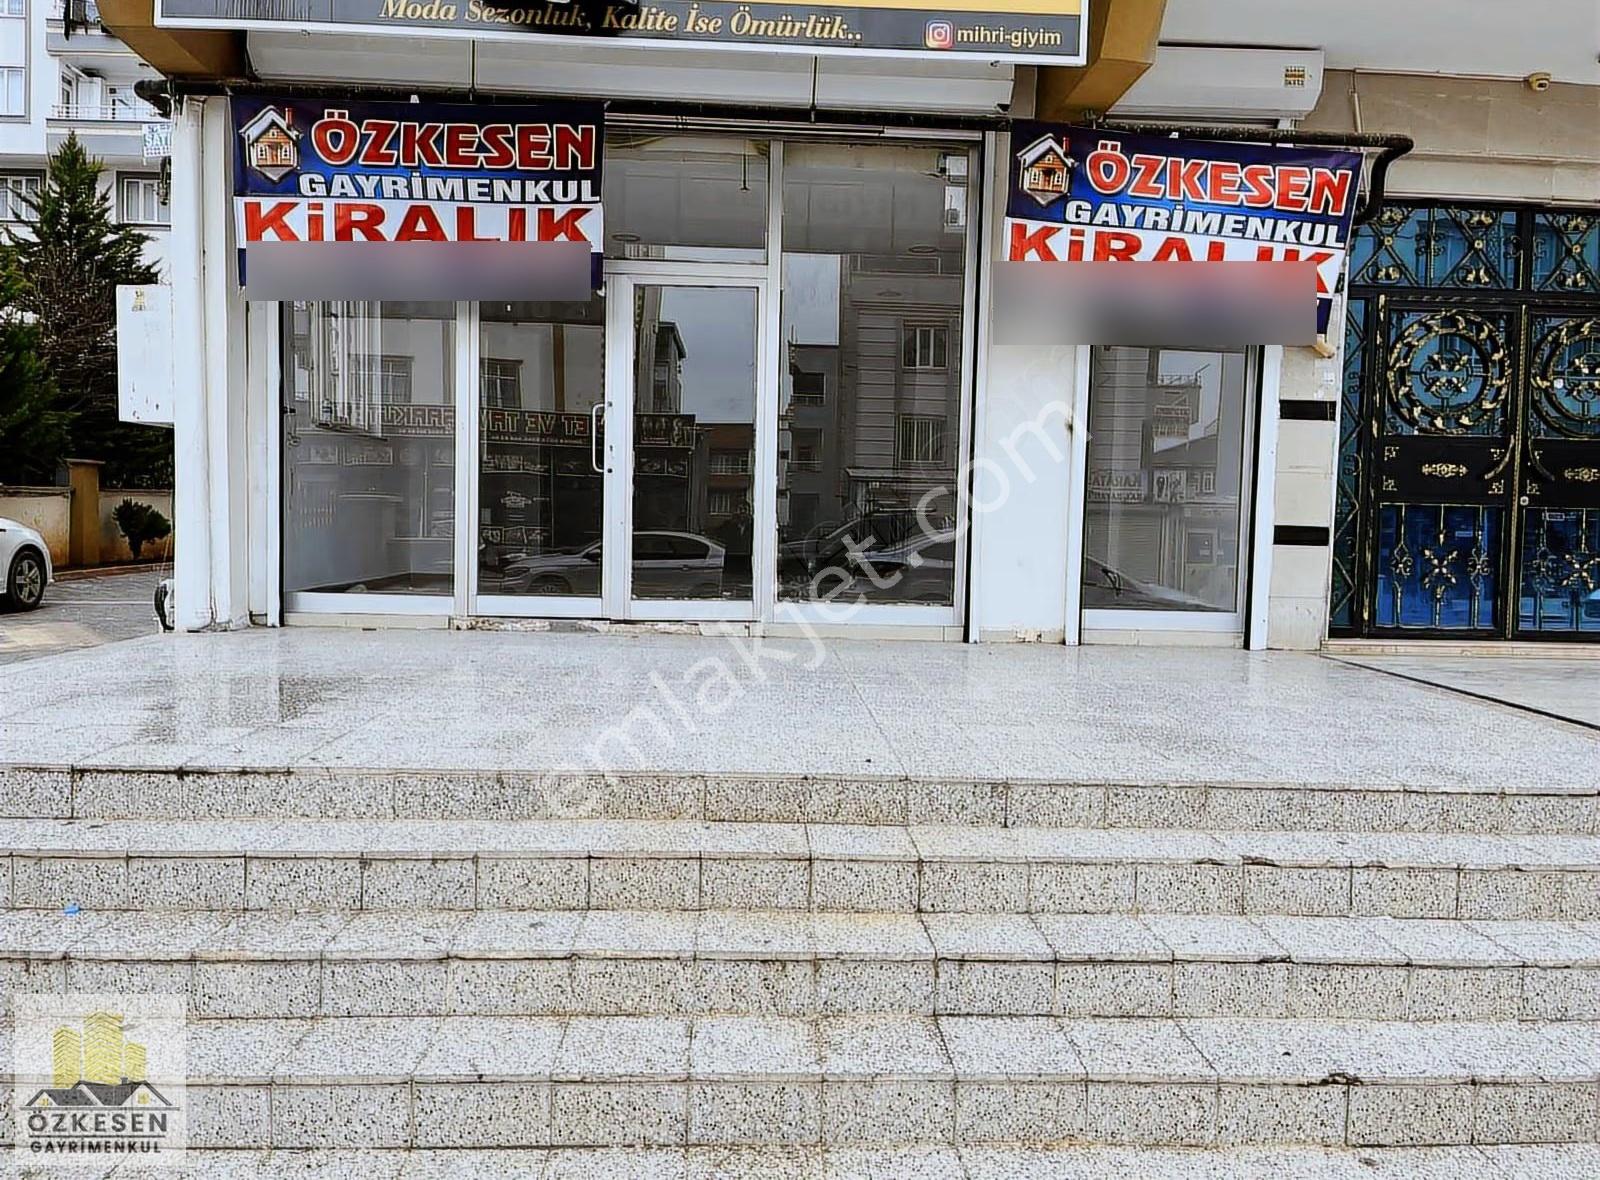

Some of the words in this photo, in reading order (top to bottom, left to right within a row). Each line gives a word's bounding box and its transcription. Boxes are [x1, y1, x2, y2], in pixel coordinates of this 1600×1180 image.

[379, 0, 457, 20] Moda
[464, 0, 592, 31] Sezonluk,
[600, 5, 678, 31] Kalite
[683, 3, 722, 34] İse
[730, 5, 863, 41] Ömürlük..
[957, 25, 1062, 48] mihri-giyim
[311, 108, 596, 171] ÖZKESEN
[299, 171, 601, 203] GAYRİMENKUL
[1086, 139, 1353, 216] ÖZKESEN
[1065, 200, 1346, 248] GAYRİMENKUL
